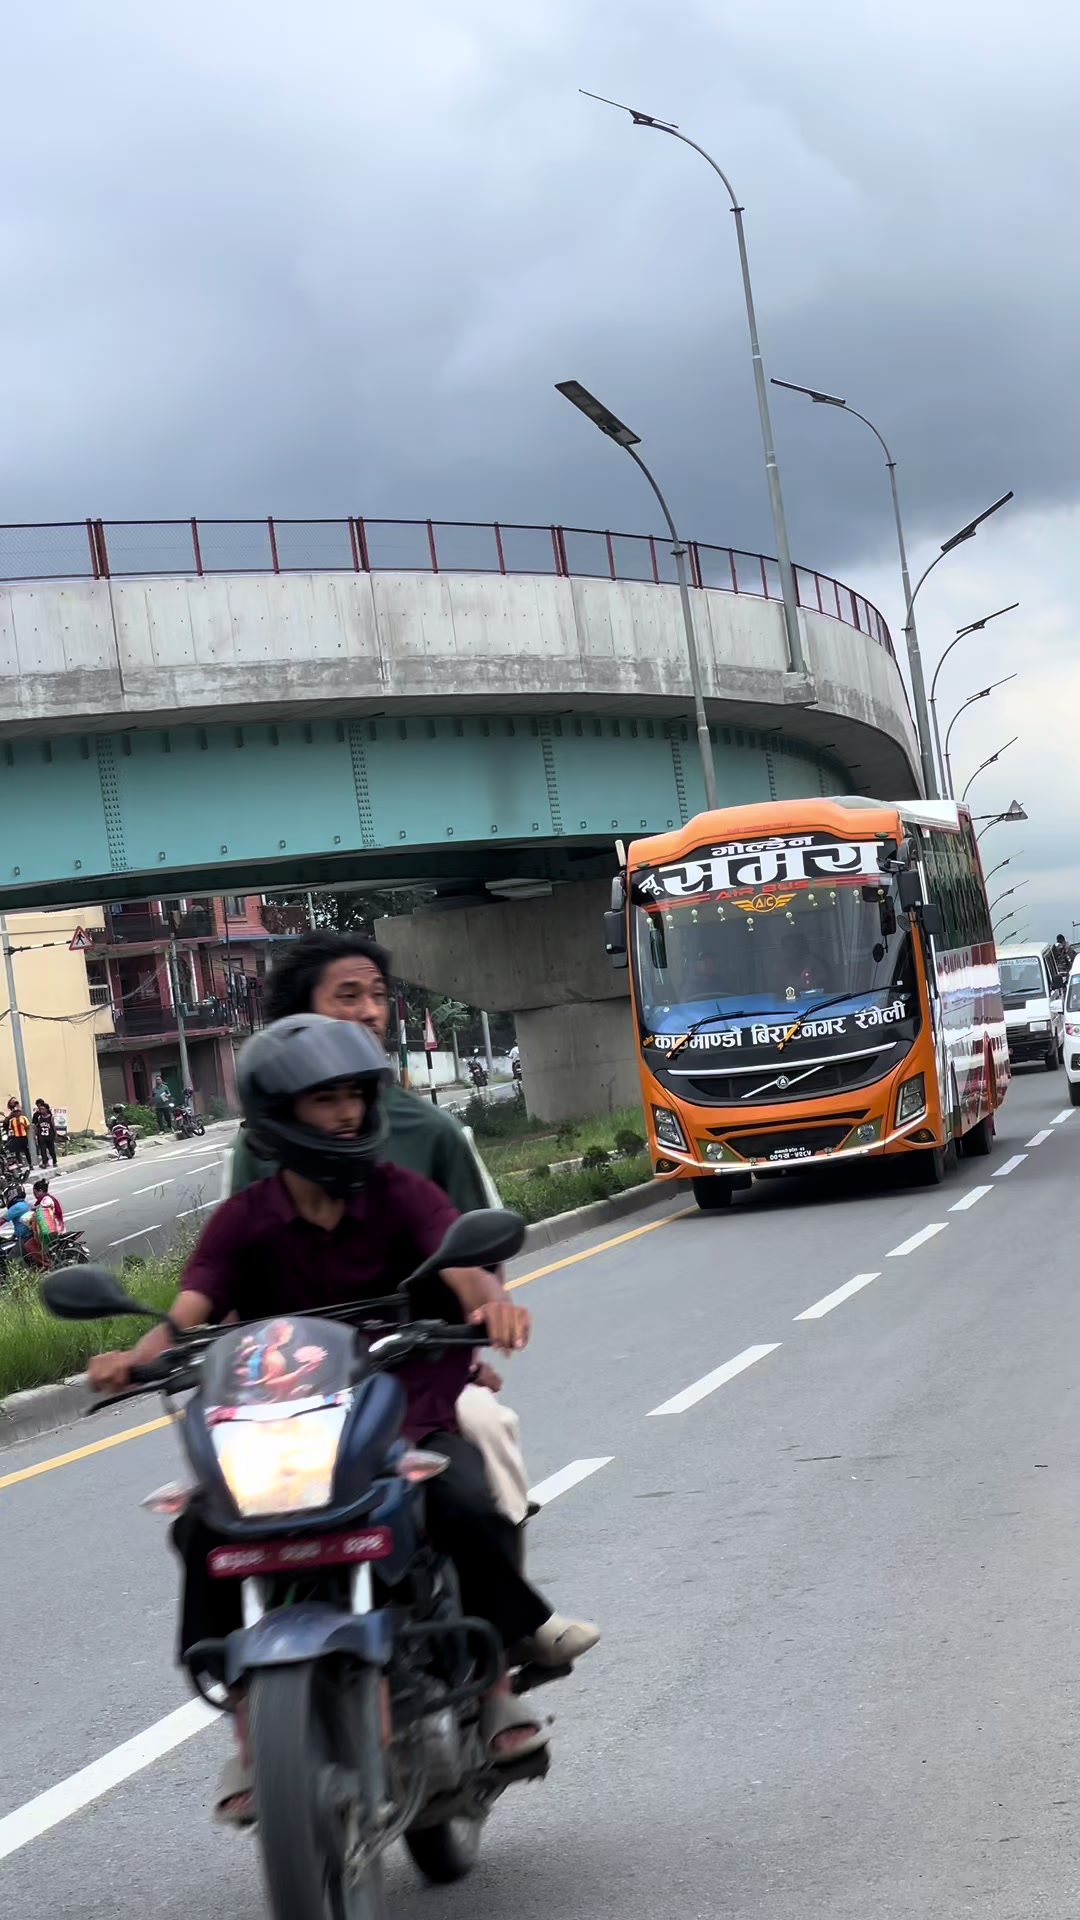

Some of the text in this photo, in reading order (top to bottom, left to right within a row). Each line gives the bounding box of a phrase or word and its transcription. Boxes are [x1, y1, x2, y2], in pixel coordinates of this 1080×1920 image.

[711, 835, 814, 857] गोल्डेन
[659, 841, 886, 896] समय
[714, 880, 809, 900] AIR BUS
